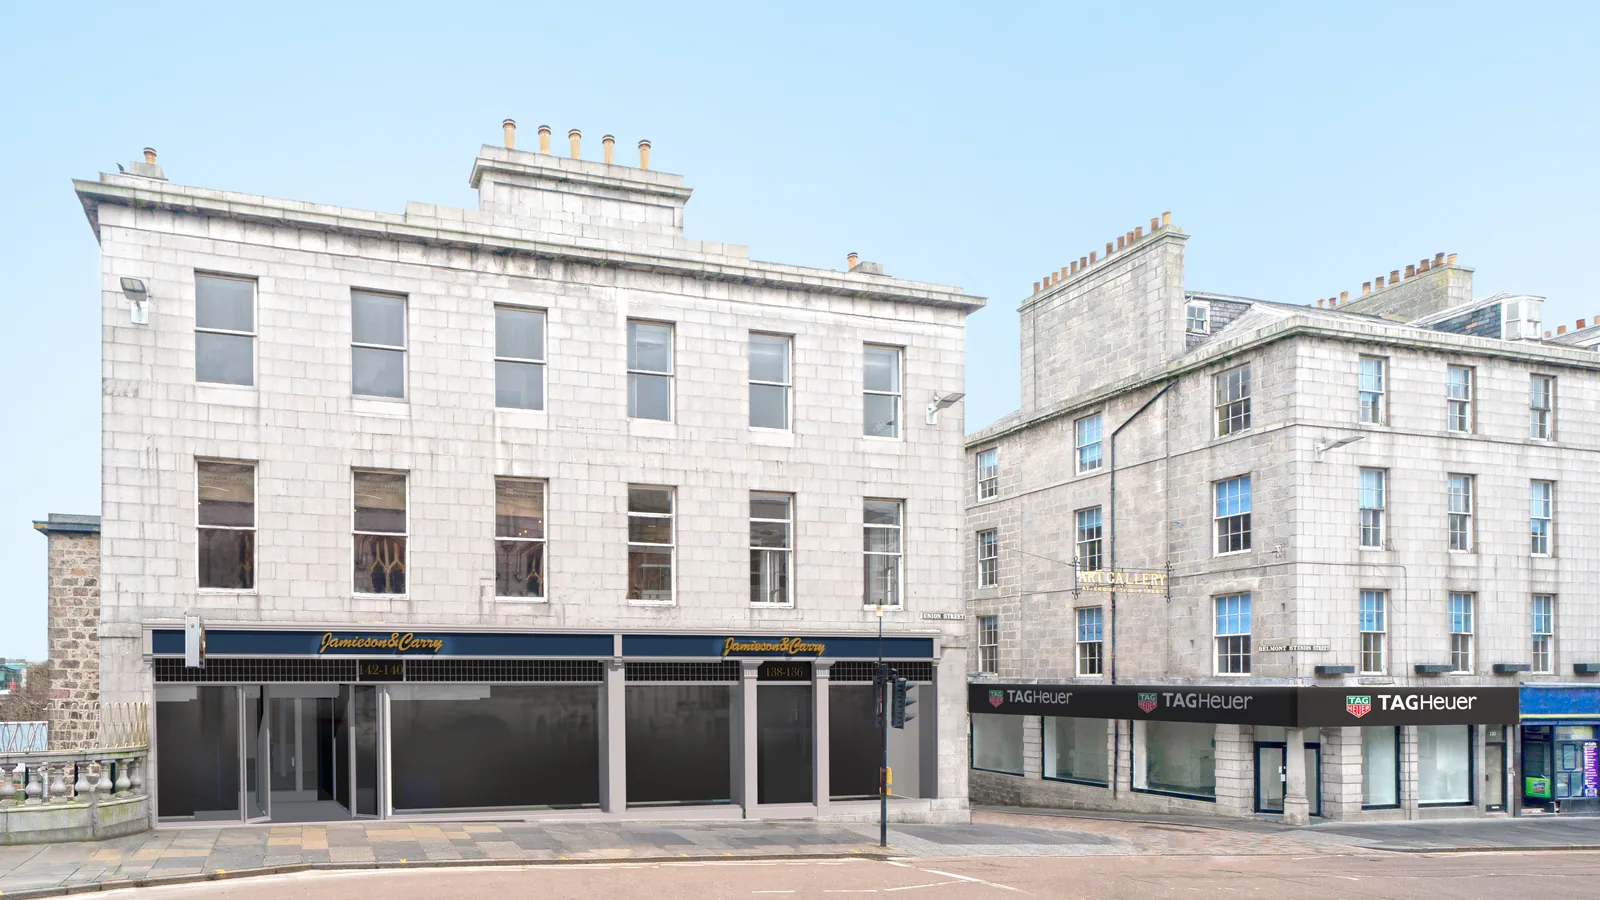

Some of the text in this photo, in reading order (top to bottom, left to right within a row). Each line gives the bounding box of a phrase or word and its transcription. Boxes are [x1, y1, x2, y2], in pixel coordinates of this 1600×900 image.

[1078, 571, 1166, 585] ART GALLERY
[359, 664, 404, 675] 142-140
[766, 667, 803, 677] 138-136
[1138, 701, 1157, 712] HEUER
[1347, 705, 1370, 716] HEUER
